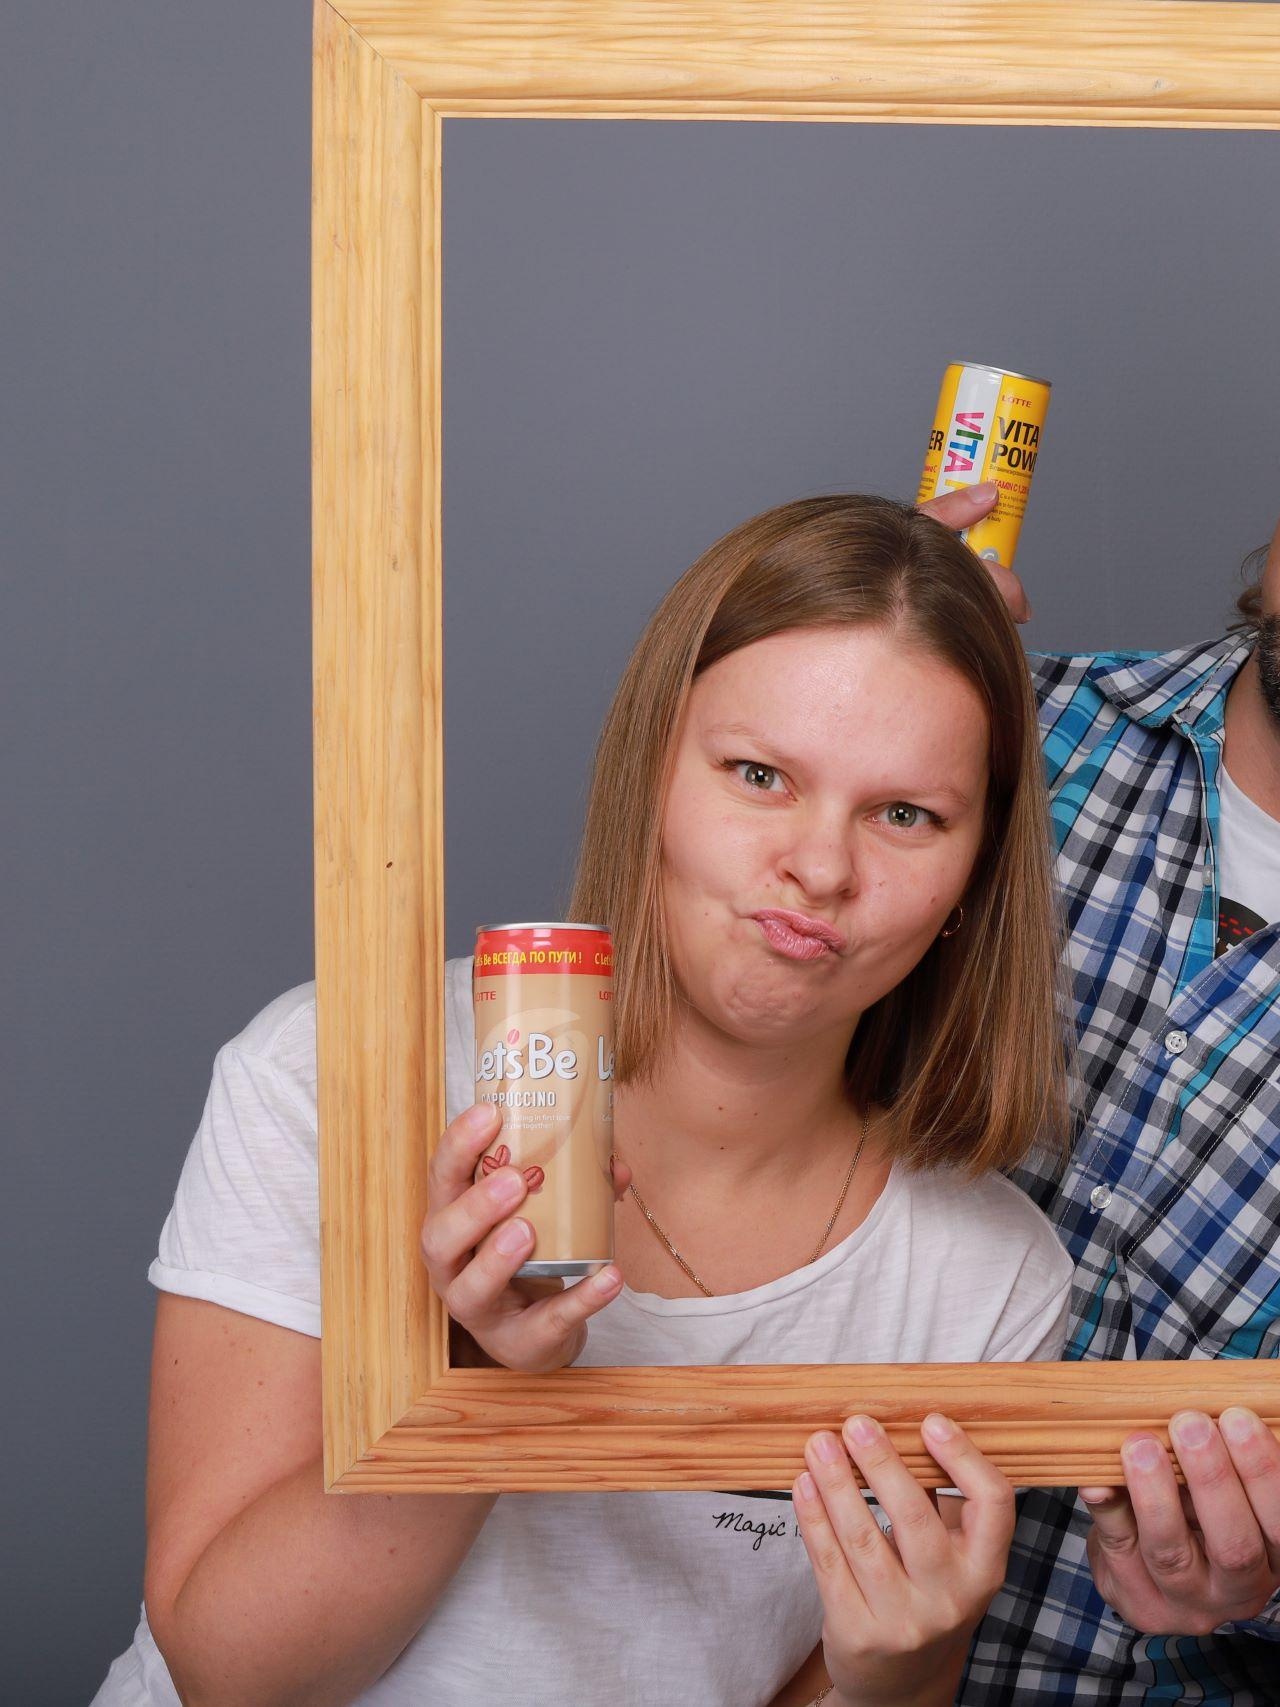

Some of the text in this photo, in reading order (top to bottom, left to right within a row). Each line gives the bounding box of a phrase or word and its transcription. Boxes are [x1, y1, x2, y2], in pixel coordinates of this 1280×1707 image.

[1001, 394, 1033, 408] LOTTE
[944, 412, 985, 473] VITA
[998, 416, 1040, 449] VITA
[991, 442, 1038, 474] POW
[492, 951, 527, 966] ВСЕГДА
[529, 951, 546, 964] ПО
[548, 951, 577, 964] ПУТИ
[528, 1033, 579, 1081] Be
[712, 1511, 786, 1551] Magic
